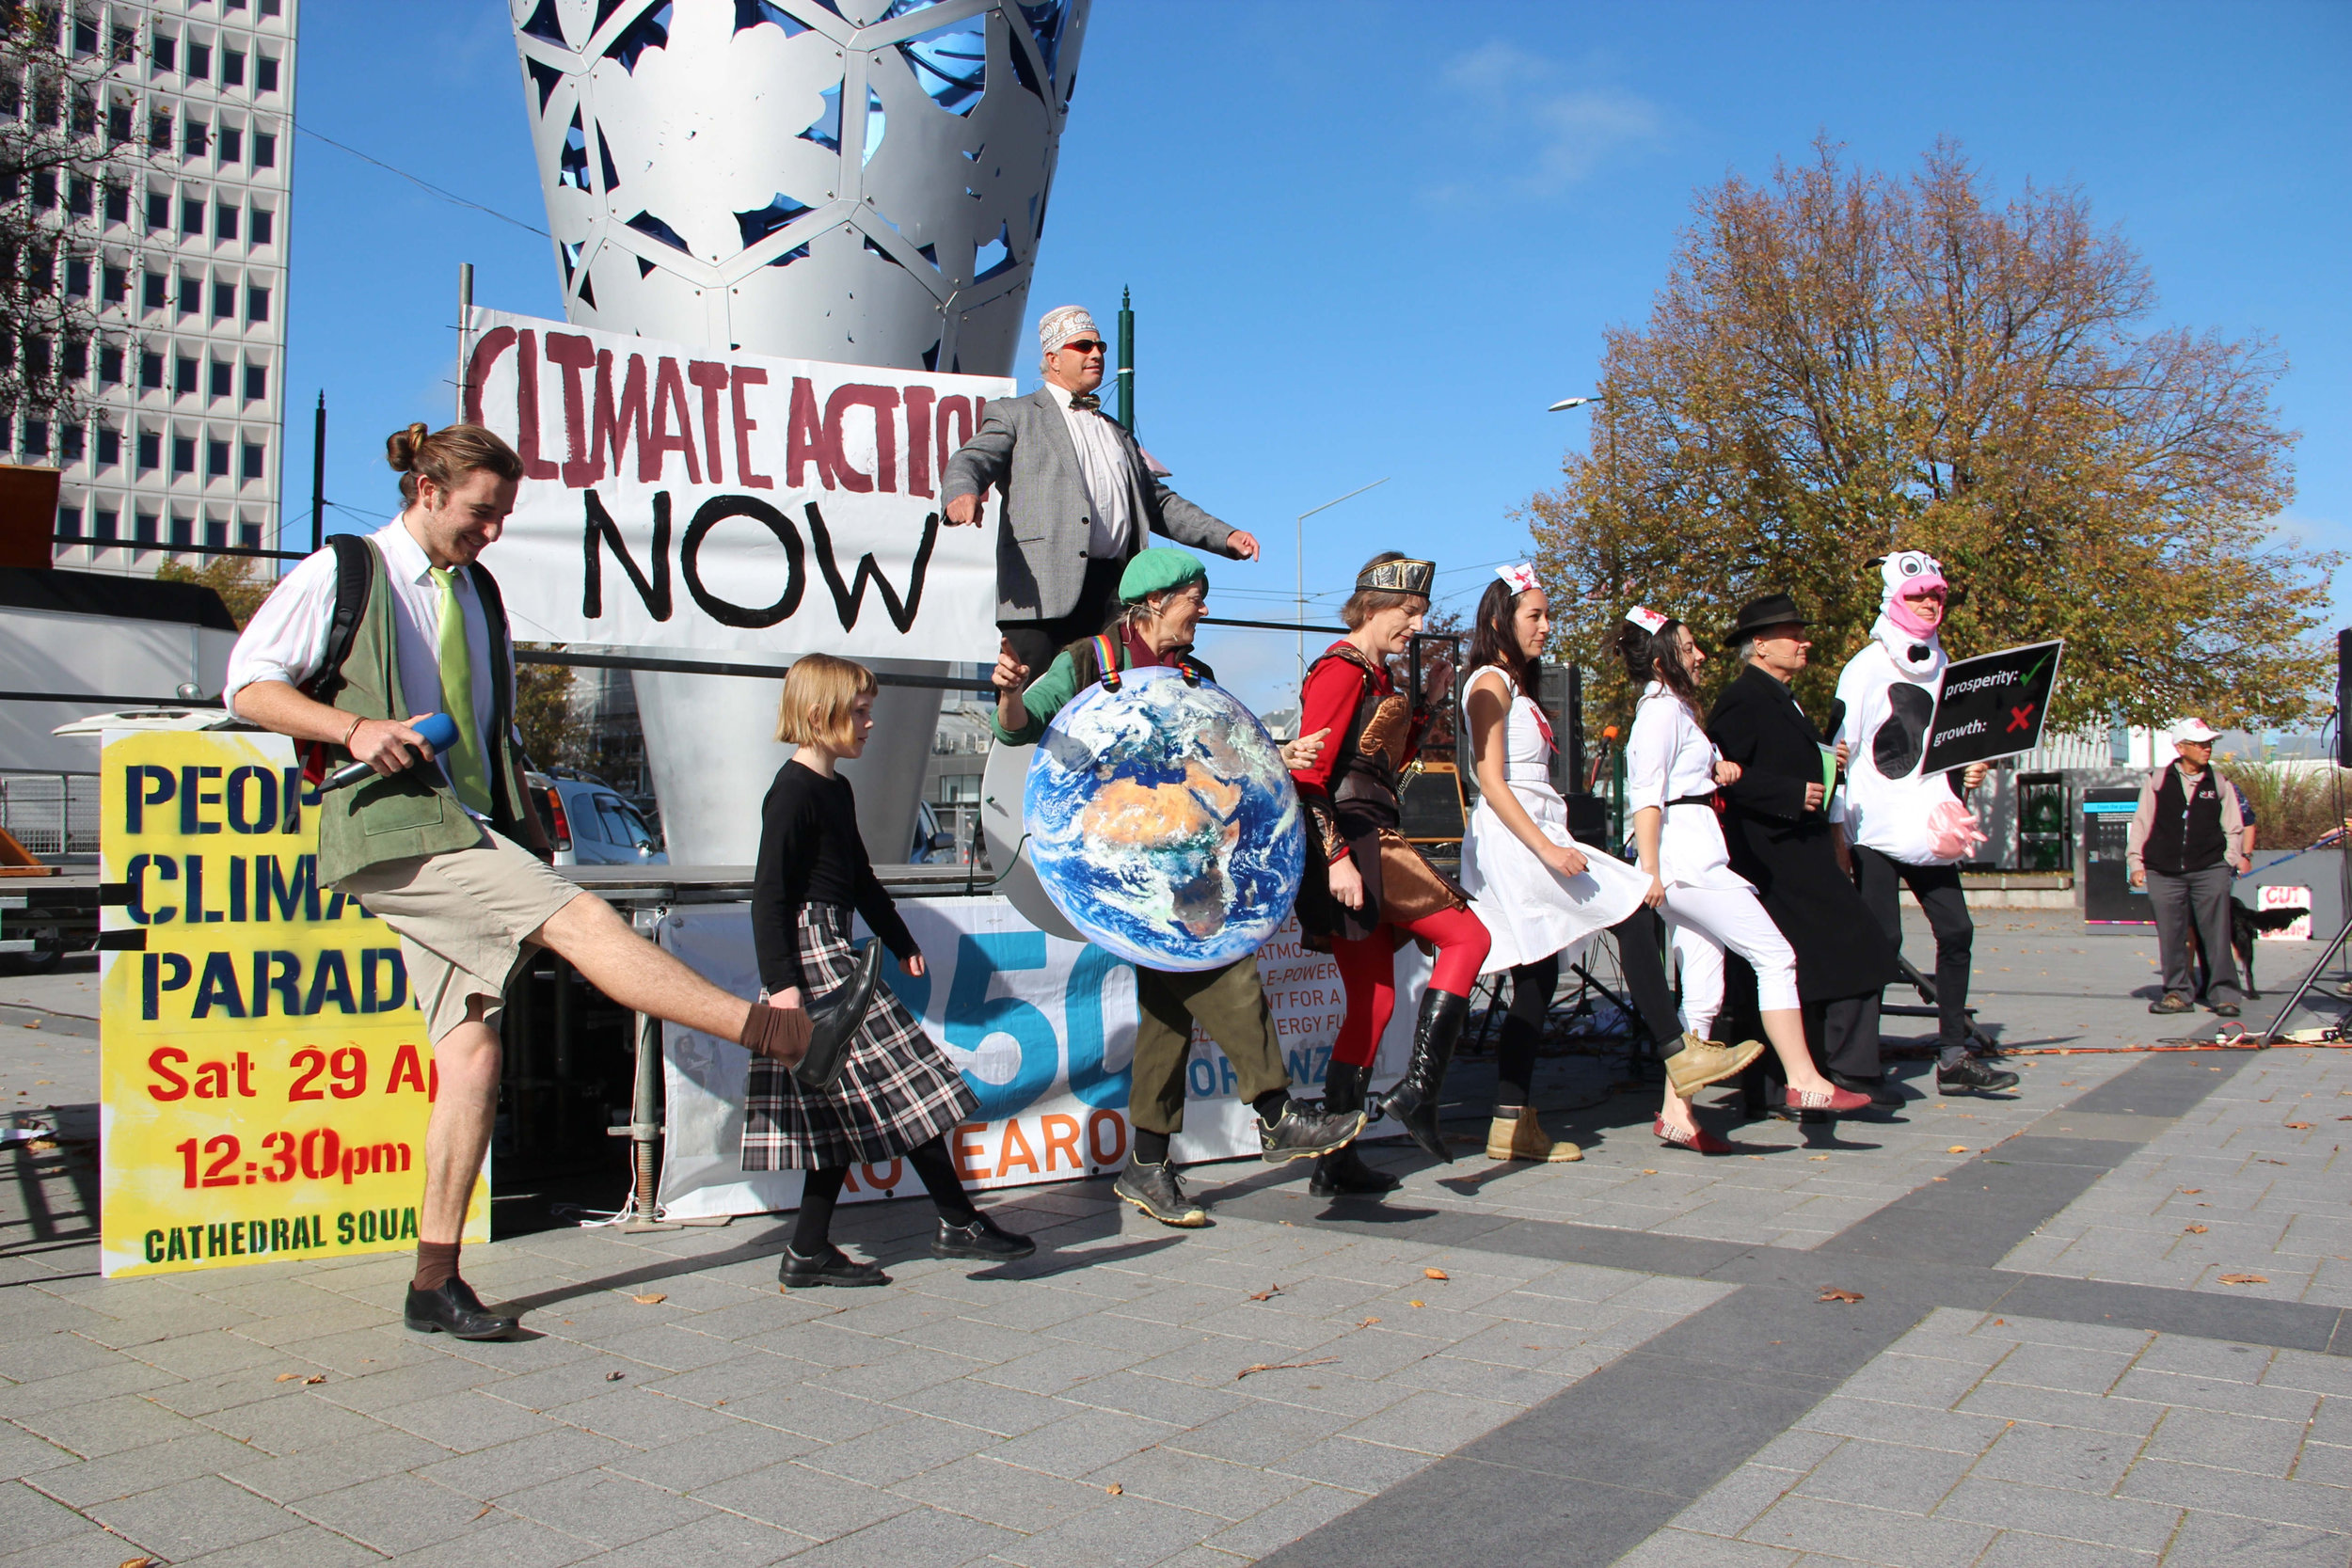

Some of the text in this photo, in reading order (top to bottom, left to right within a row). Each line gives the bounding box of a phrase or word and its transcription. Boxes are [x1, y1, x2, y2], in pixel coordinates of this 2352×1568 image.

[464, 325, 774, 490] CLIMATE
[581, 488, 939, 634] NOW
[1944, 670, 2020, 701] prosperity:
[1932, 719, 1988, 748] growth:
[2265, 885, 2298, 905] CUT
[142, 947, 421, 1021] PARAD
[1289, 990, 1325, 1008] FOR
[1329, 989, 1342, 1006] A
[147, 1044, 438, 1103] Sat 29 A
[1287, 1044, 1333, 1085] NZ
[175, 1127, 411, 1189] 12:30pm
[144, 1205, 420, 1264] CATHEDRAL SQUA
